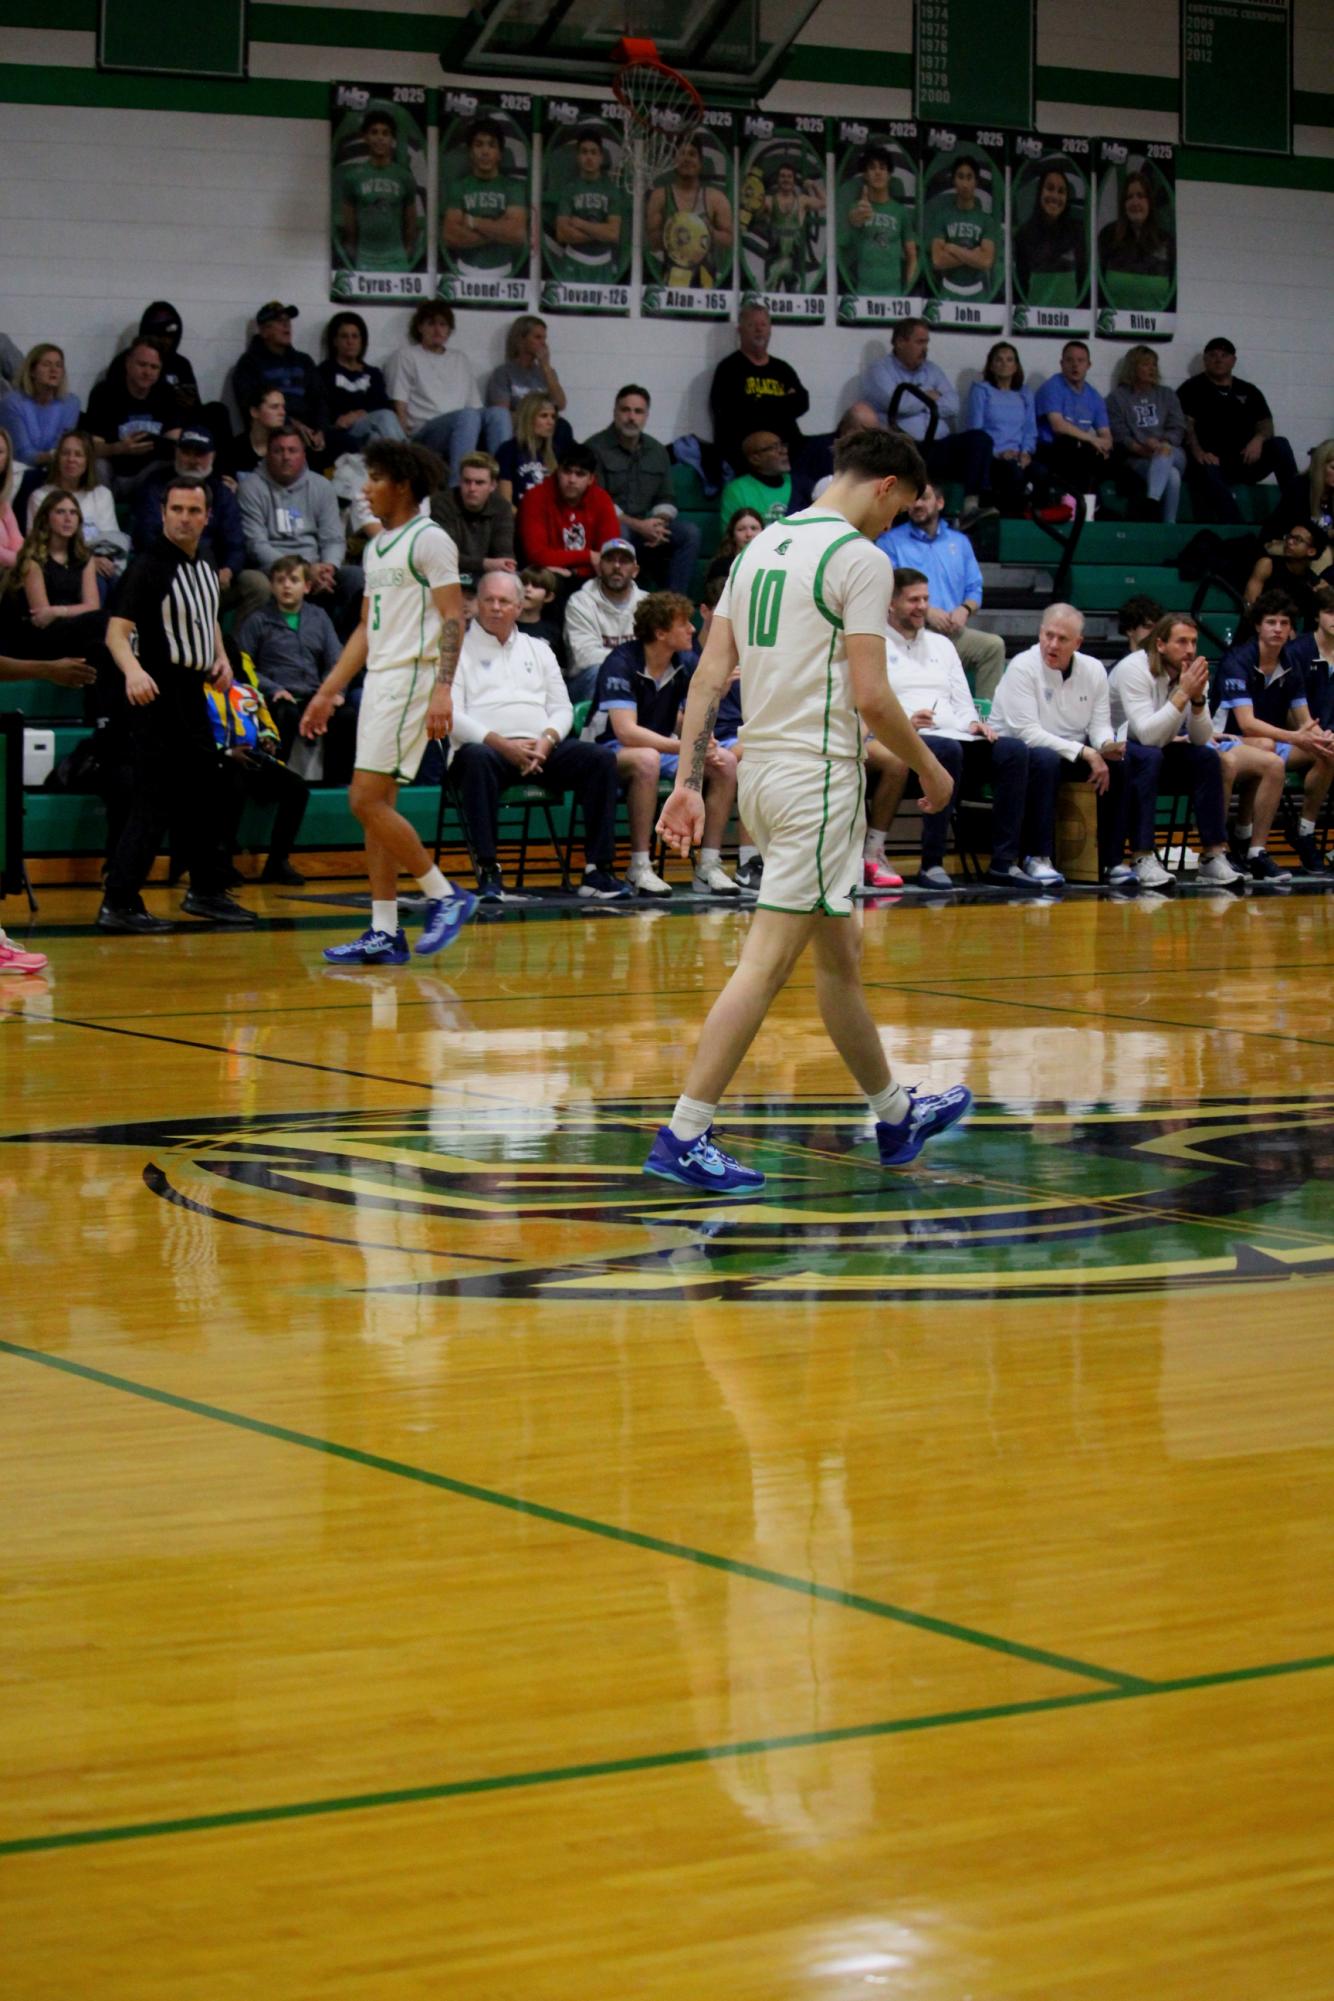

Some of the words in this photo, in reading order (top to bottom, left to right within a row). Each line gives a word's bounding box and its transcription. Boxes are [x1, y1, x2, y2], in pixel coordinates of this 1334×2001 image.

[921, 22, 949, 38] 1975
[1186, 31, 1214, 47] 2010
[921, 55, 948, 70] 1977
[1186, 48, 1213, 63] 2012
[393, 86, 426, 103] 2025
[499, 94, 531, 112] 2025
[703, 110, 733, 126] 2025
[795, 116, 824, 133] 2025
[889, 121, 917, 138] 2025
[976, 131, 1004, 147] 2025
[1062, 138, 1090, 154] 2025
[1146, 143, 1173, 159] 2025
[361, 178, 400, 196] WEST
[463, 191, 506, 211] WEST
[573, 192, 608, 213] WEST
[947, 221, 982, 241] WEST
[666, 290, 694, 308] Alan
[705, 294, 727, 310] 165
[804, 298, 825, 314] 190
[955, 306, 981, 322] John
[1037, 310, 1070, 328] Inasia
[1130, 314, 1157, 331] Riley
[372, 594, 381, 631] 5
[748, 568, 788, 648] 10
